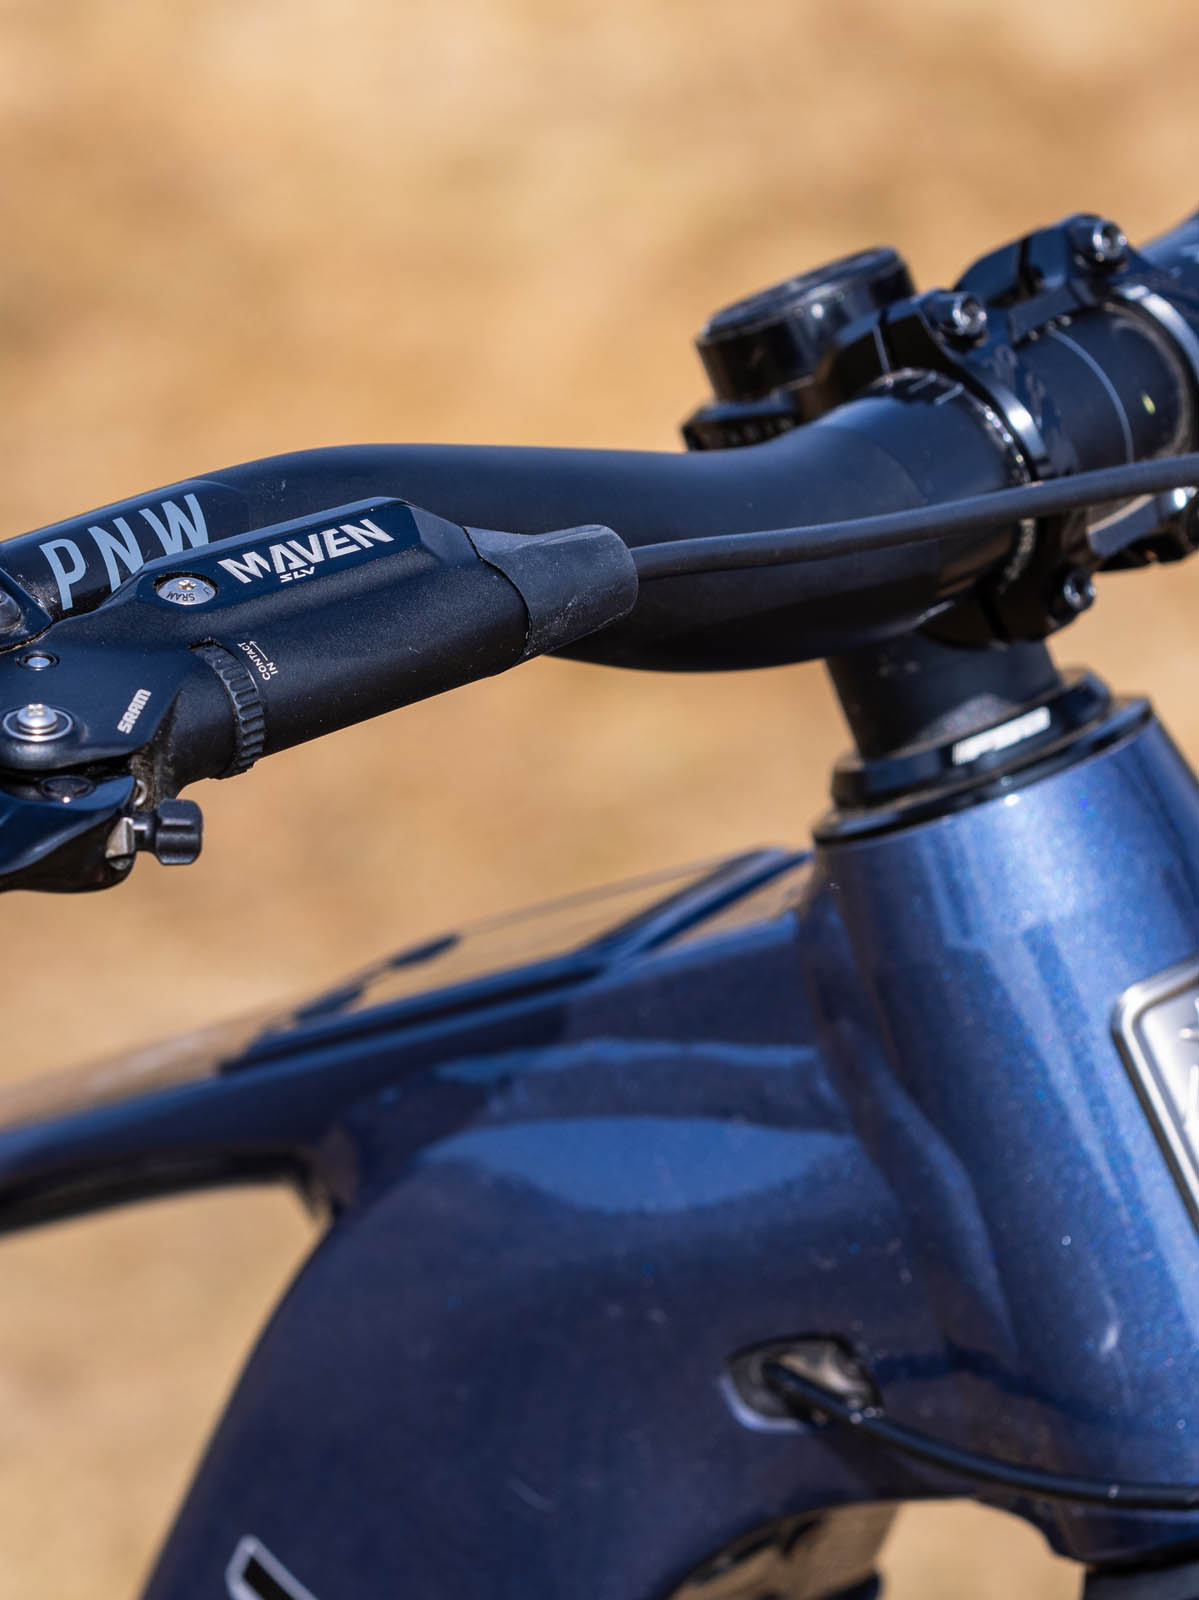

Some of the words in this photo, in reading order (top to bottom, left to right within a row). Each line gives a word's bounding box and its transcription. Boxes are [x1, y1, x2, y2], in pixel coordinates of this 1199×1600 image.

[39, 494, 209, 611] PNW
[217, 518, 395, 584] MAVEN
[280, 566, 315, 583] SLV
[166, 590, 196, 602] SRAM
[237, 642, 271, 681] CONTACT
[266, 660, 279, 676] IN
[117, 689, 152, 734] SRAM
